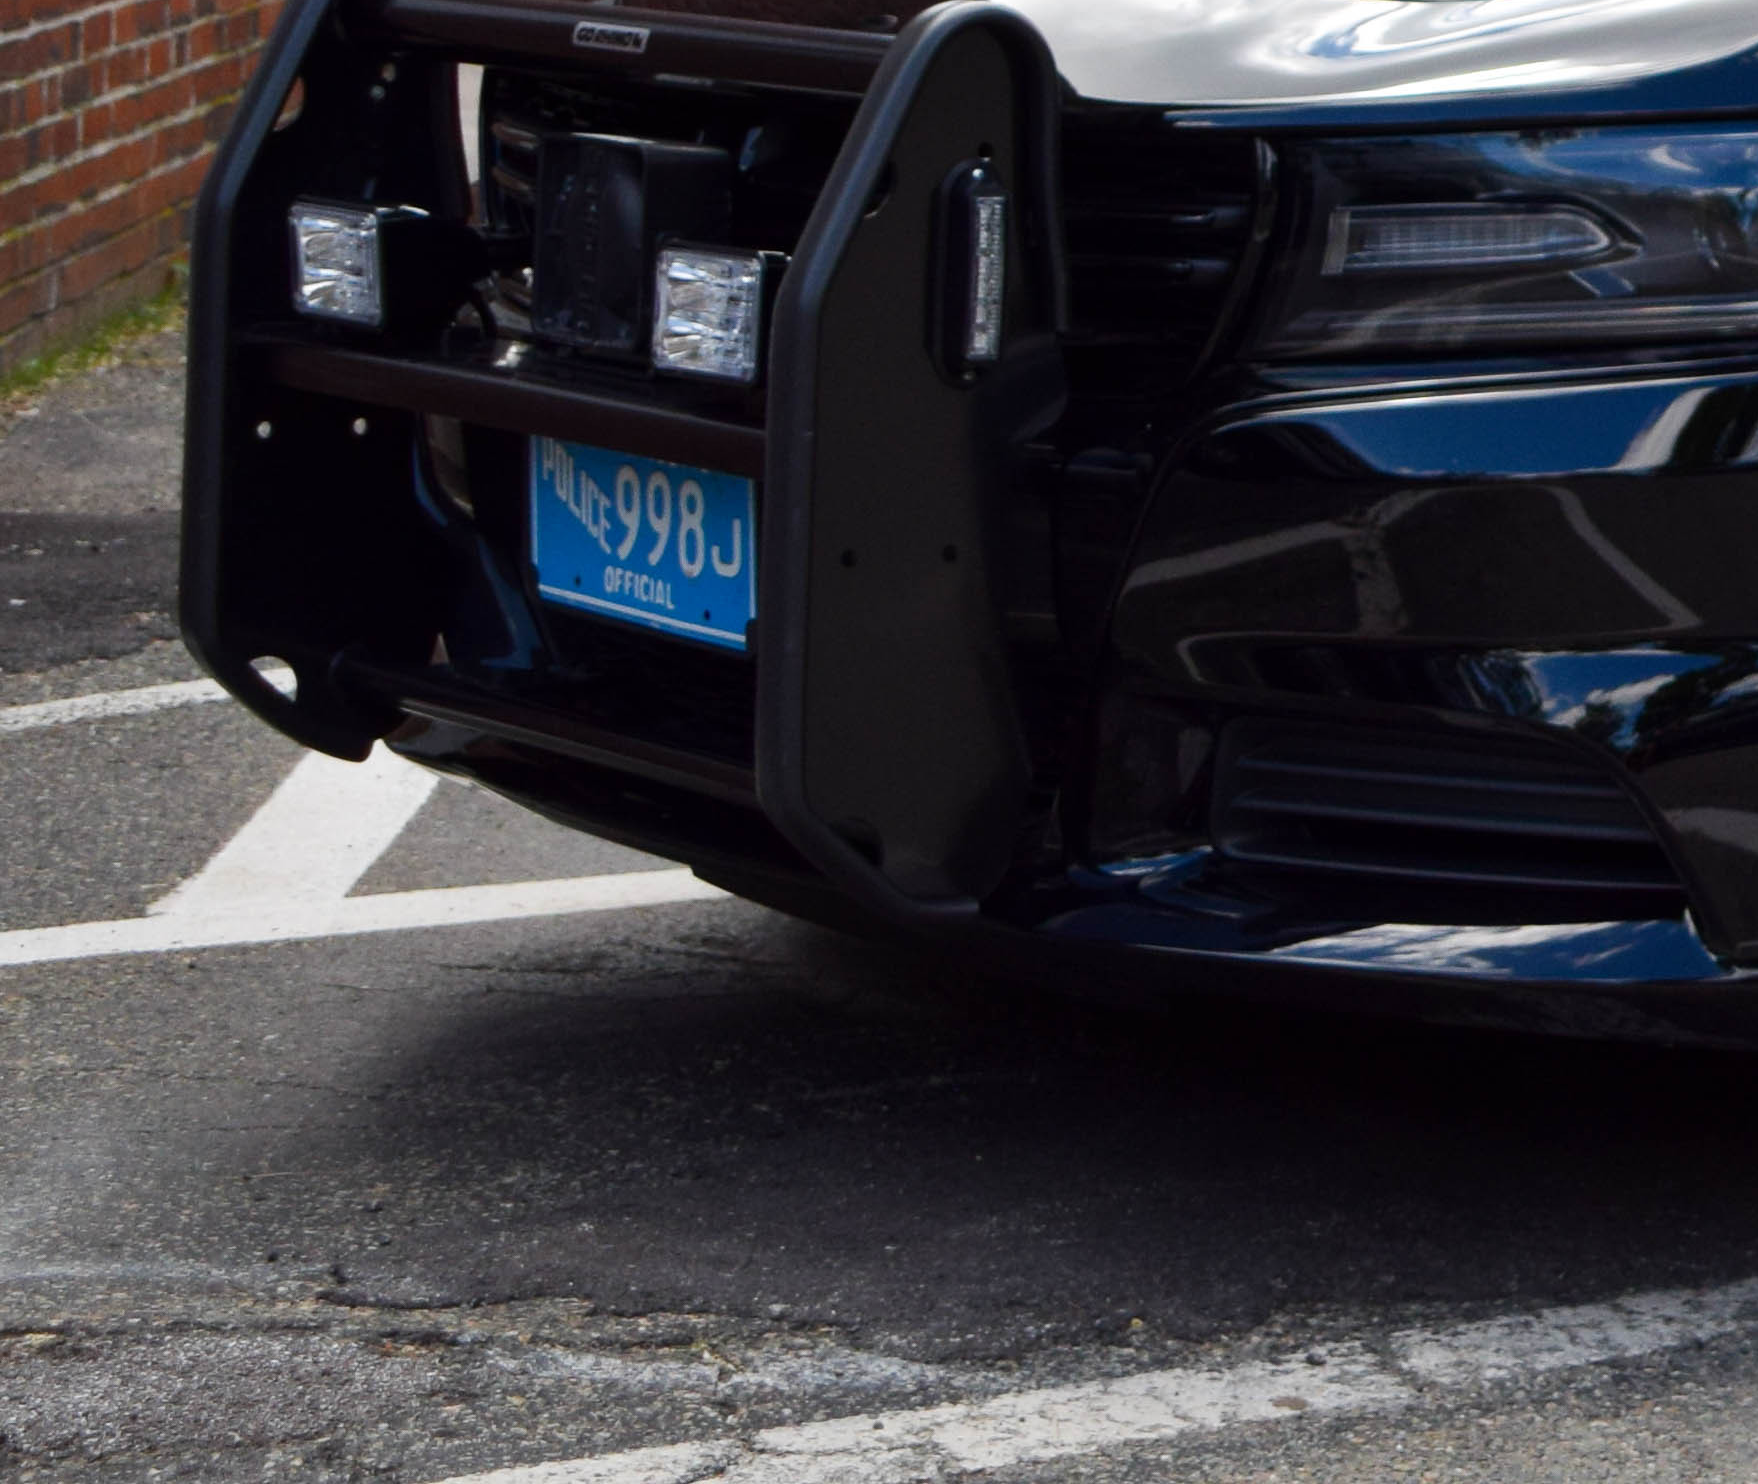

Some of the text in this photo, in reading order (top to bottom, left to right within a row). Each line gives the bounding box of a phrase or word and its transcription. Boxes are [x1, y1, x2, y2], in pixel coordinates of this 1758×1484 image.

[541, 437, 742, 578] POLICE 998J
[603, 565, 675, 610] OFFICIAL
